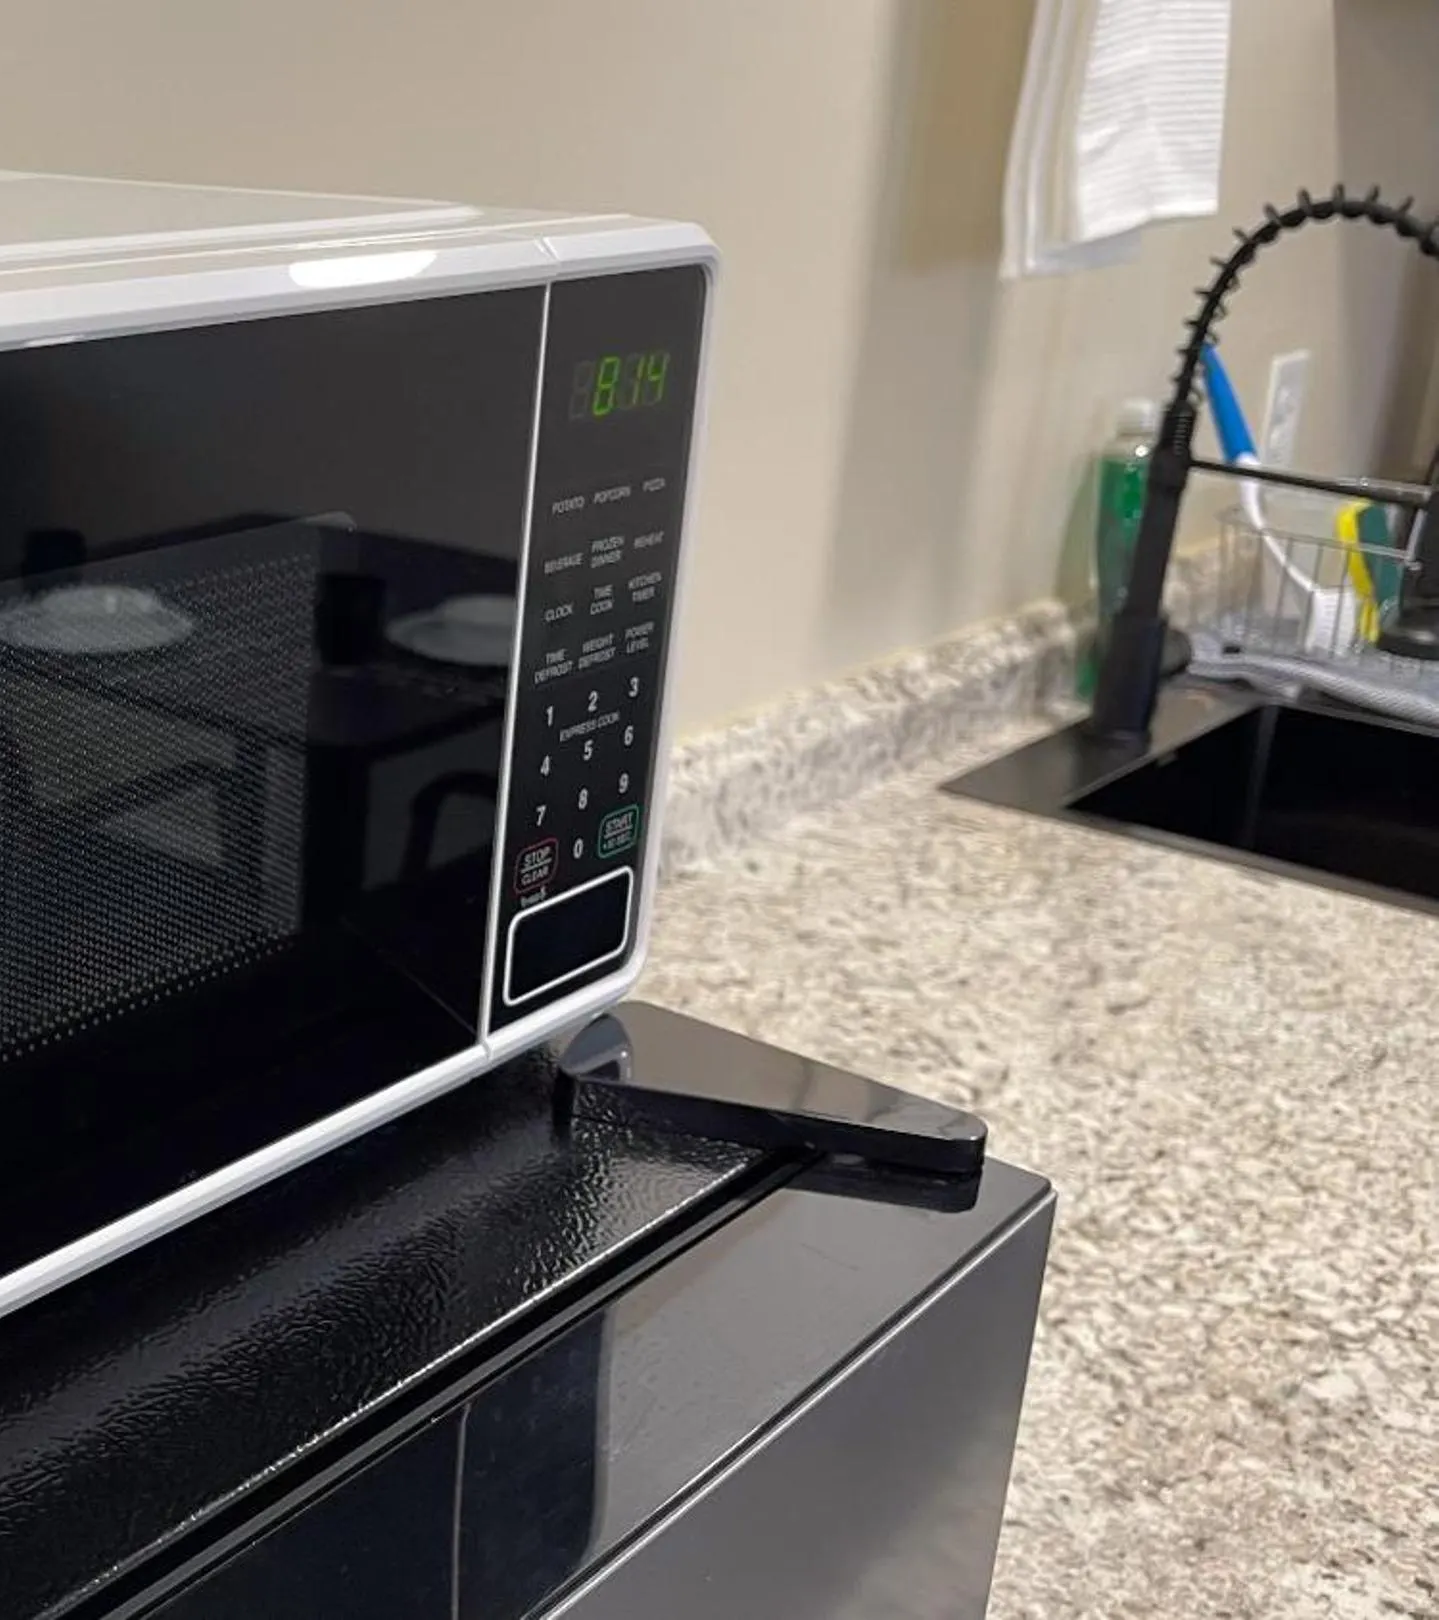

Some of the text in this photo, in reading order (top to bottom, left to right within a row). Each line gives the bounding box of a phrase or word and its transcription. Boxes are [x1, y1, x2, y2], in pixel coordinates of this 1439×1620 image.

[552, 496, 585, 515] POTATO
[594, 486, 631, 504] POPCORN
[591, 536, 624, 552] FROZEN
[628, 572, 662, 589] KITCHEN
[594, 585, 613, 599] TIME
[544, 603, 574, 622] CLOCK
[590, 600, 613, 615] COOK
[625, 622, 655, 639] POWER
[583, 634, 614, 653] WEIGHT
[626, 637, 649, 653] LEVEL
[546, 649, 566, 664] TIME
[578, 647, 616, 669] DEFROST
[535, 660, 574, 684] DEFROST
[628, 676, 640, 698] 3
[588, 690, 599, 712] 2
[546, 705, 555, 727] 1
[560, 711, 620, 743] EXPRESS COOK
[624, 725, 634, 746] 6
[583, 739, 594, 761] 5
[540, 755, 551, 776] 4
[619, 772, 630, 794] 9
[578, 788, 589, 810] 8
[536, 804, 548, 827] 7
[605, 811, 634, 834] START
[524, 846, 552, 868] STOP
[573, 837, 584, 860] 0
[520, 866, 549, 886] CLEAR
